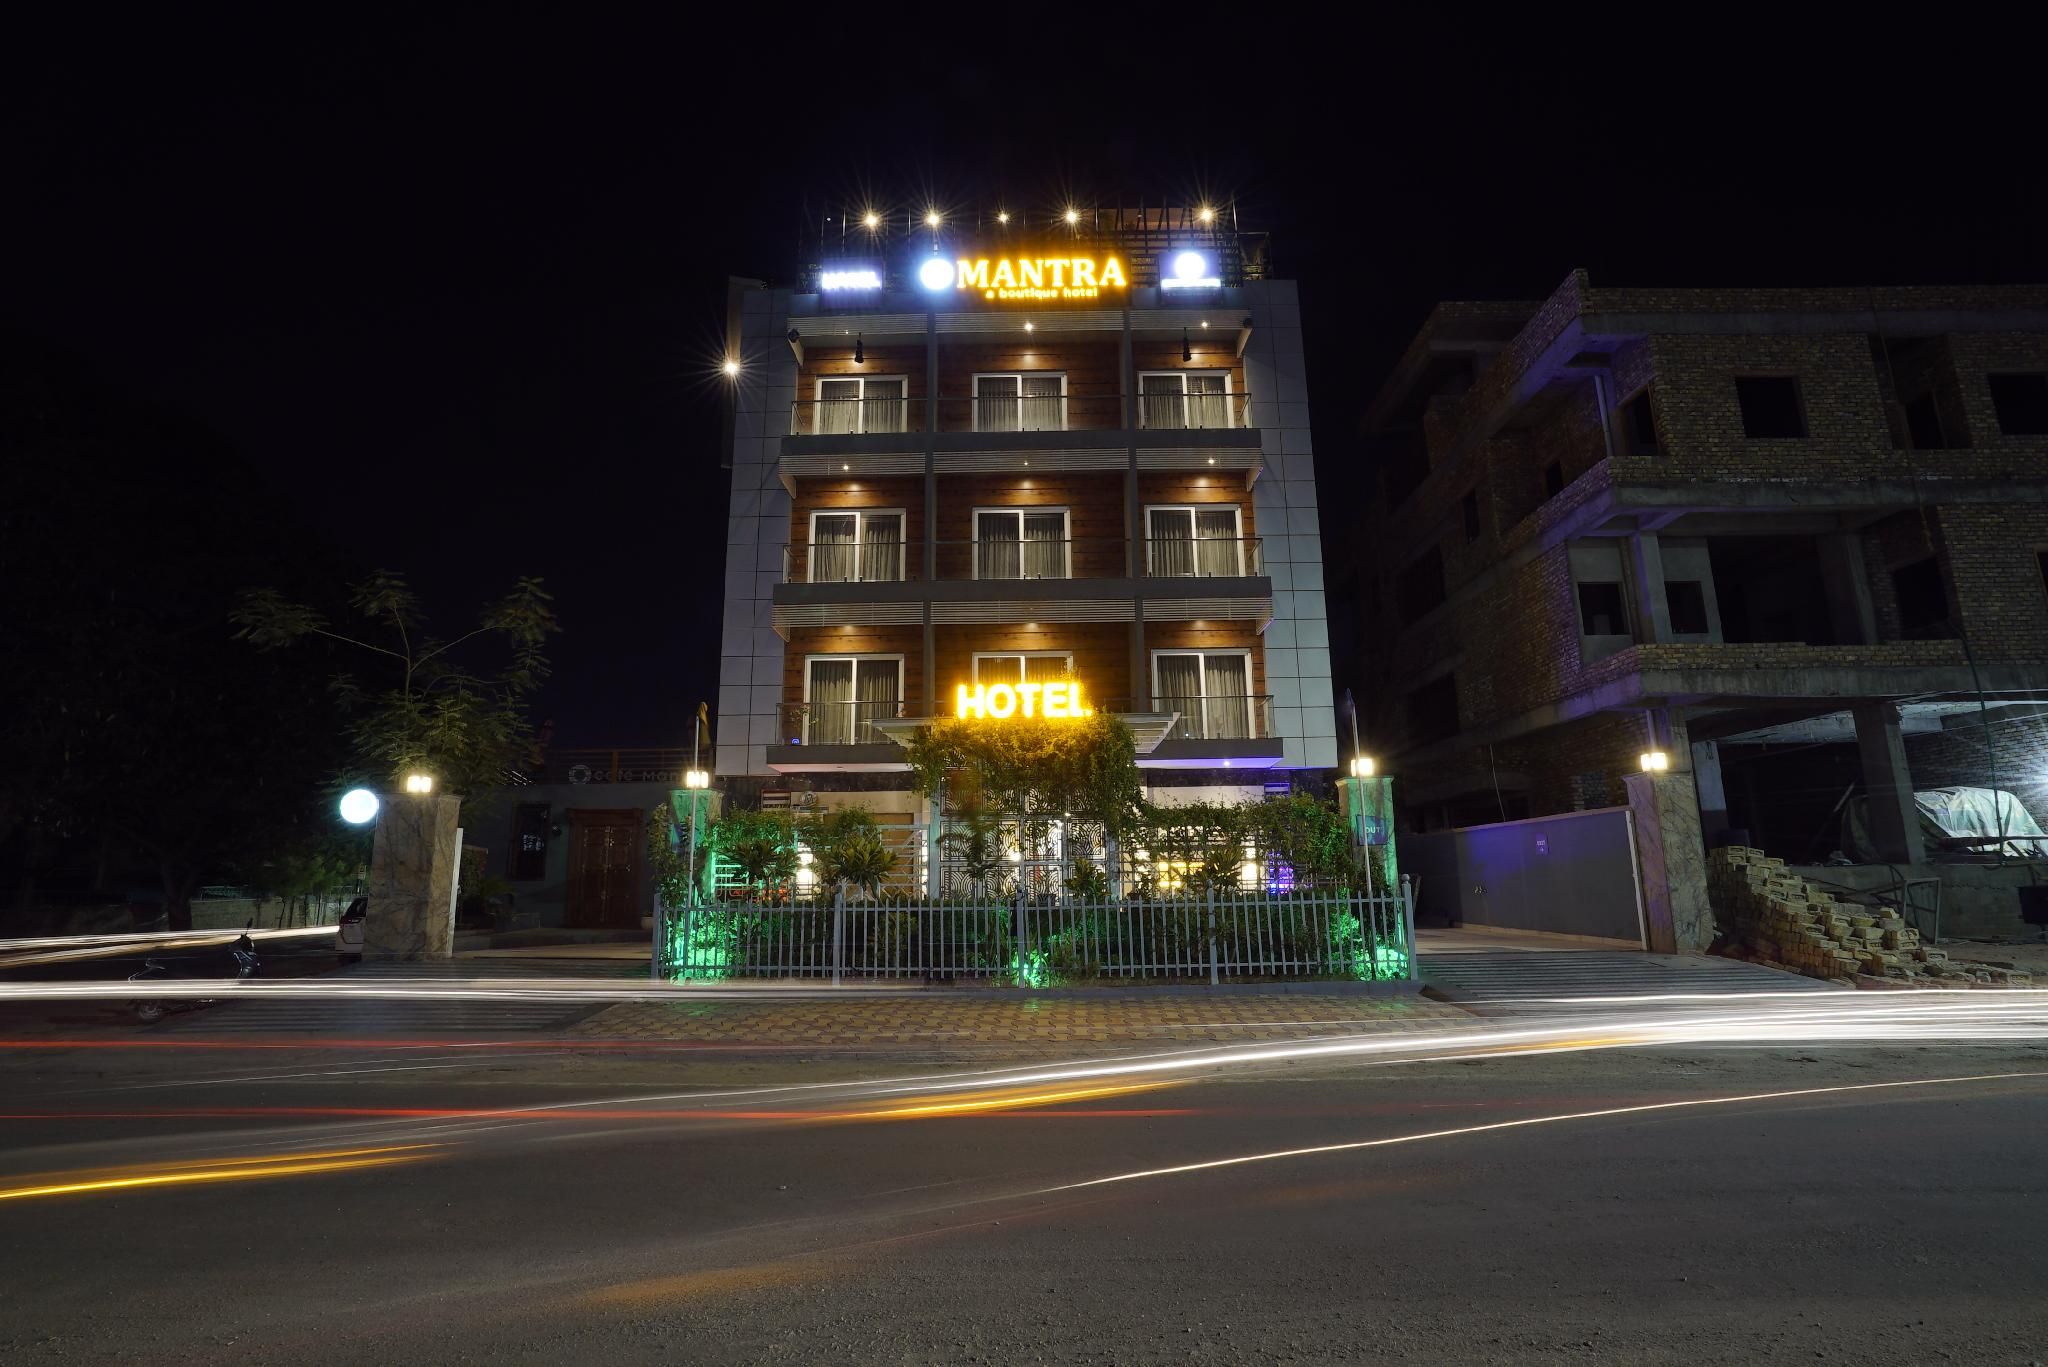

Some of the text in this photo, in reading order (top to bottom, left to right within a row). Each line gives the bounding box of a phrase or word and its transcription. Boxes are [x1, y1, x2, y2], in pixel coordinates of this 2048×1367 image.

[956, 257, 1127, 288] MANTRA
[985, 286, 1098, 299] a boutique hotel
[956, 682, 1093, 720] HOTEL
